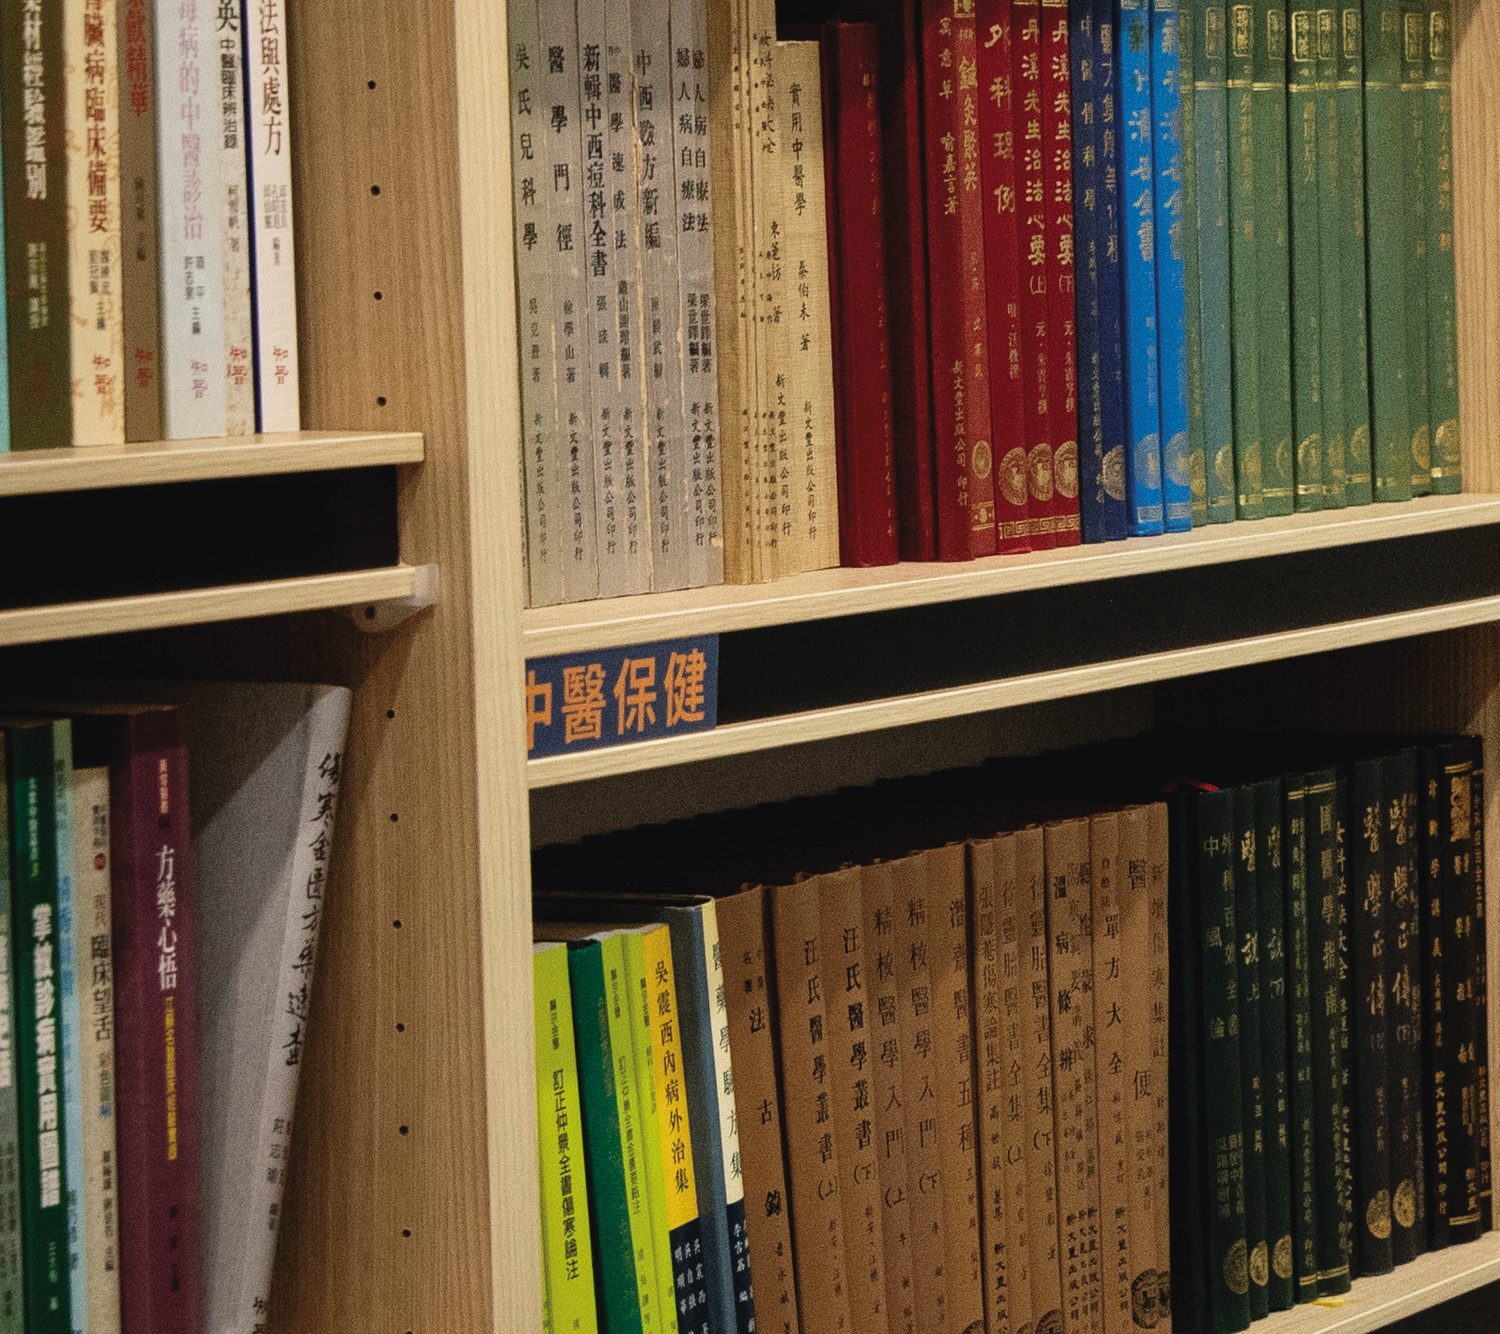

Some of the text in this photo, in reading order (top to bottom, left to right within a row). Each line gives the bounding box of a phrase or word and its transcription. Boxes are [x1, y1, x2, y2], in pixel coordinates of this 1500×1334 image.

[1022, 19, 1046, 265] 丹溪先生治法心要
[1052, 20, 1075, 265] 丹溪先生治法心要
[525, 647, 708, 751] 中醫保健
[155, 845, 178, 992] 方藥心悟
[654, 960, 690, 1195] 吳震西內病外治集
